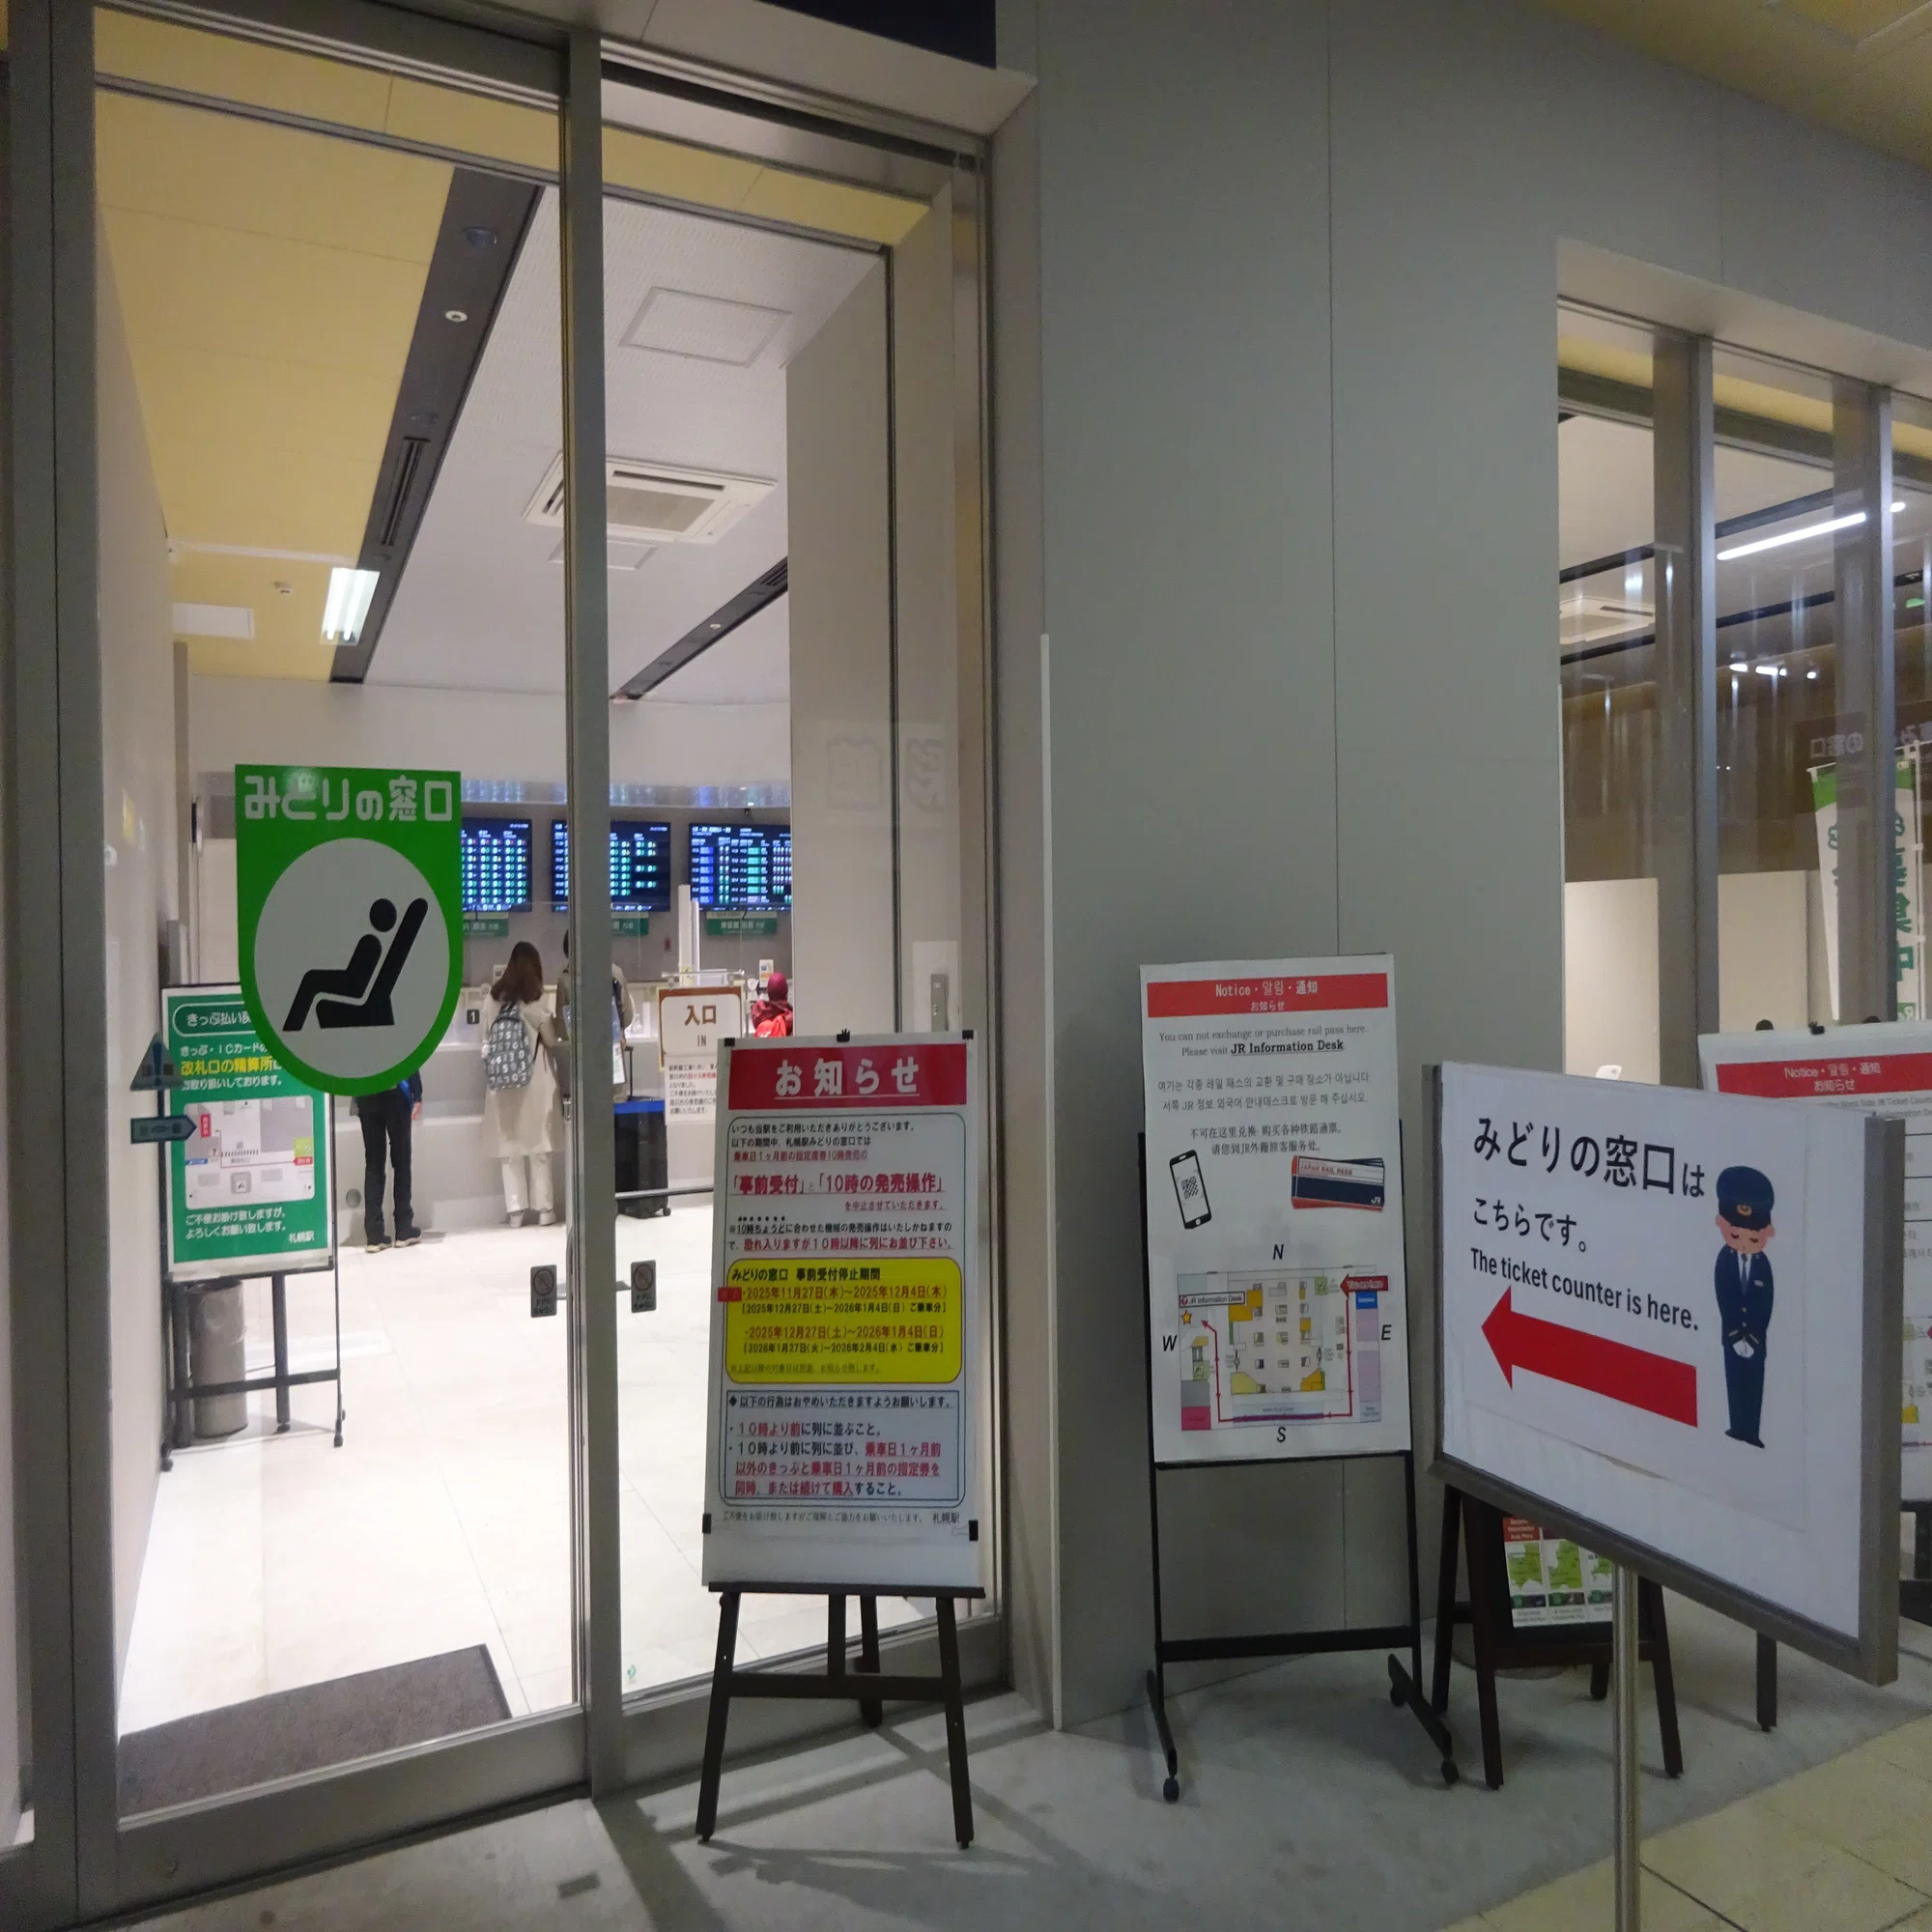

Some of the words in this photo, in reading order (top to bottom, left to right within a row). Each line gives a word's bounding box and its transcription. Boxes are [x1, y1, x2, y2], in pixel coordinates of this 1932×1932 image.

[244, 775, 452, 821] みどりの窓口
[1250, 1001, 1286, 1012] お知らせ
[685, 1005, 717, 1026] 入口
[697, 1035, 706, 1047] IN
[1159, 1032, 1177, 1042] You
[1196, 1031, 1209, 1040] not
[1211, 1029, 1253, 1040] exchange
[1254, 1030, 1264, 1038] or
[1265, 1027, 1305, 1040] purchase
[1307, 1026, 1322, 1036] rail
[1324, 1027, 1345, 1037] pass
[1346, 1024, 1369, 1035] here.
[1181, 1046, 1208, 1057] Please
[1210, 1045, 1228, 1055] visit
[1230, 1043, 1246, 1055] JR
[1249, 1040, 1315, 1054] Information
[1317, 1039, 1344, 1051] Desk
[775, 1056, 919, 1097] お知らせ
[1158, 1080, 1183, 1094] 여기는
[1255, 1075, 1272, 1088] 교환
[1814, 1079, 1856, 1092] お知らせ
[1181, 1099, 1194, 1111] JR
[1197, 1097, 1214, 1110] 정보
[1474, 1118, 1705, 1198] みどりの窓口は
[1474, 1198, 1586, 1252] こちらです。
[1272, 1244, 1285, 1261] N
[731, 1268, 788, 1281] みどりの窓口
[1471, 1247, 1497, 1275] The
[1501, 1258, 1548, 1290] ticket
[1552, 1274, 1622, 1309] counter
[1627, 1288, 1642, 1315] is
[1648, 1294, 1698, 1331] here.
[1381, 1324, 1392, 1341] E
[1162, 1334, 1178, 1351] W
[1276, 1427, 1287, 1443] S
[932, 1511, 959, 1524] 札幌駅
